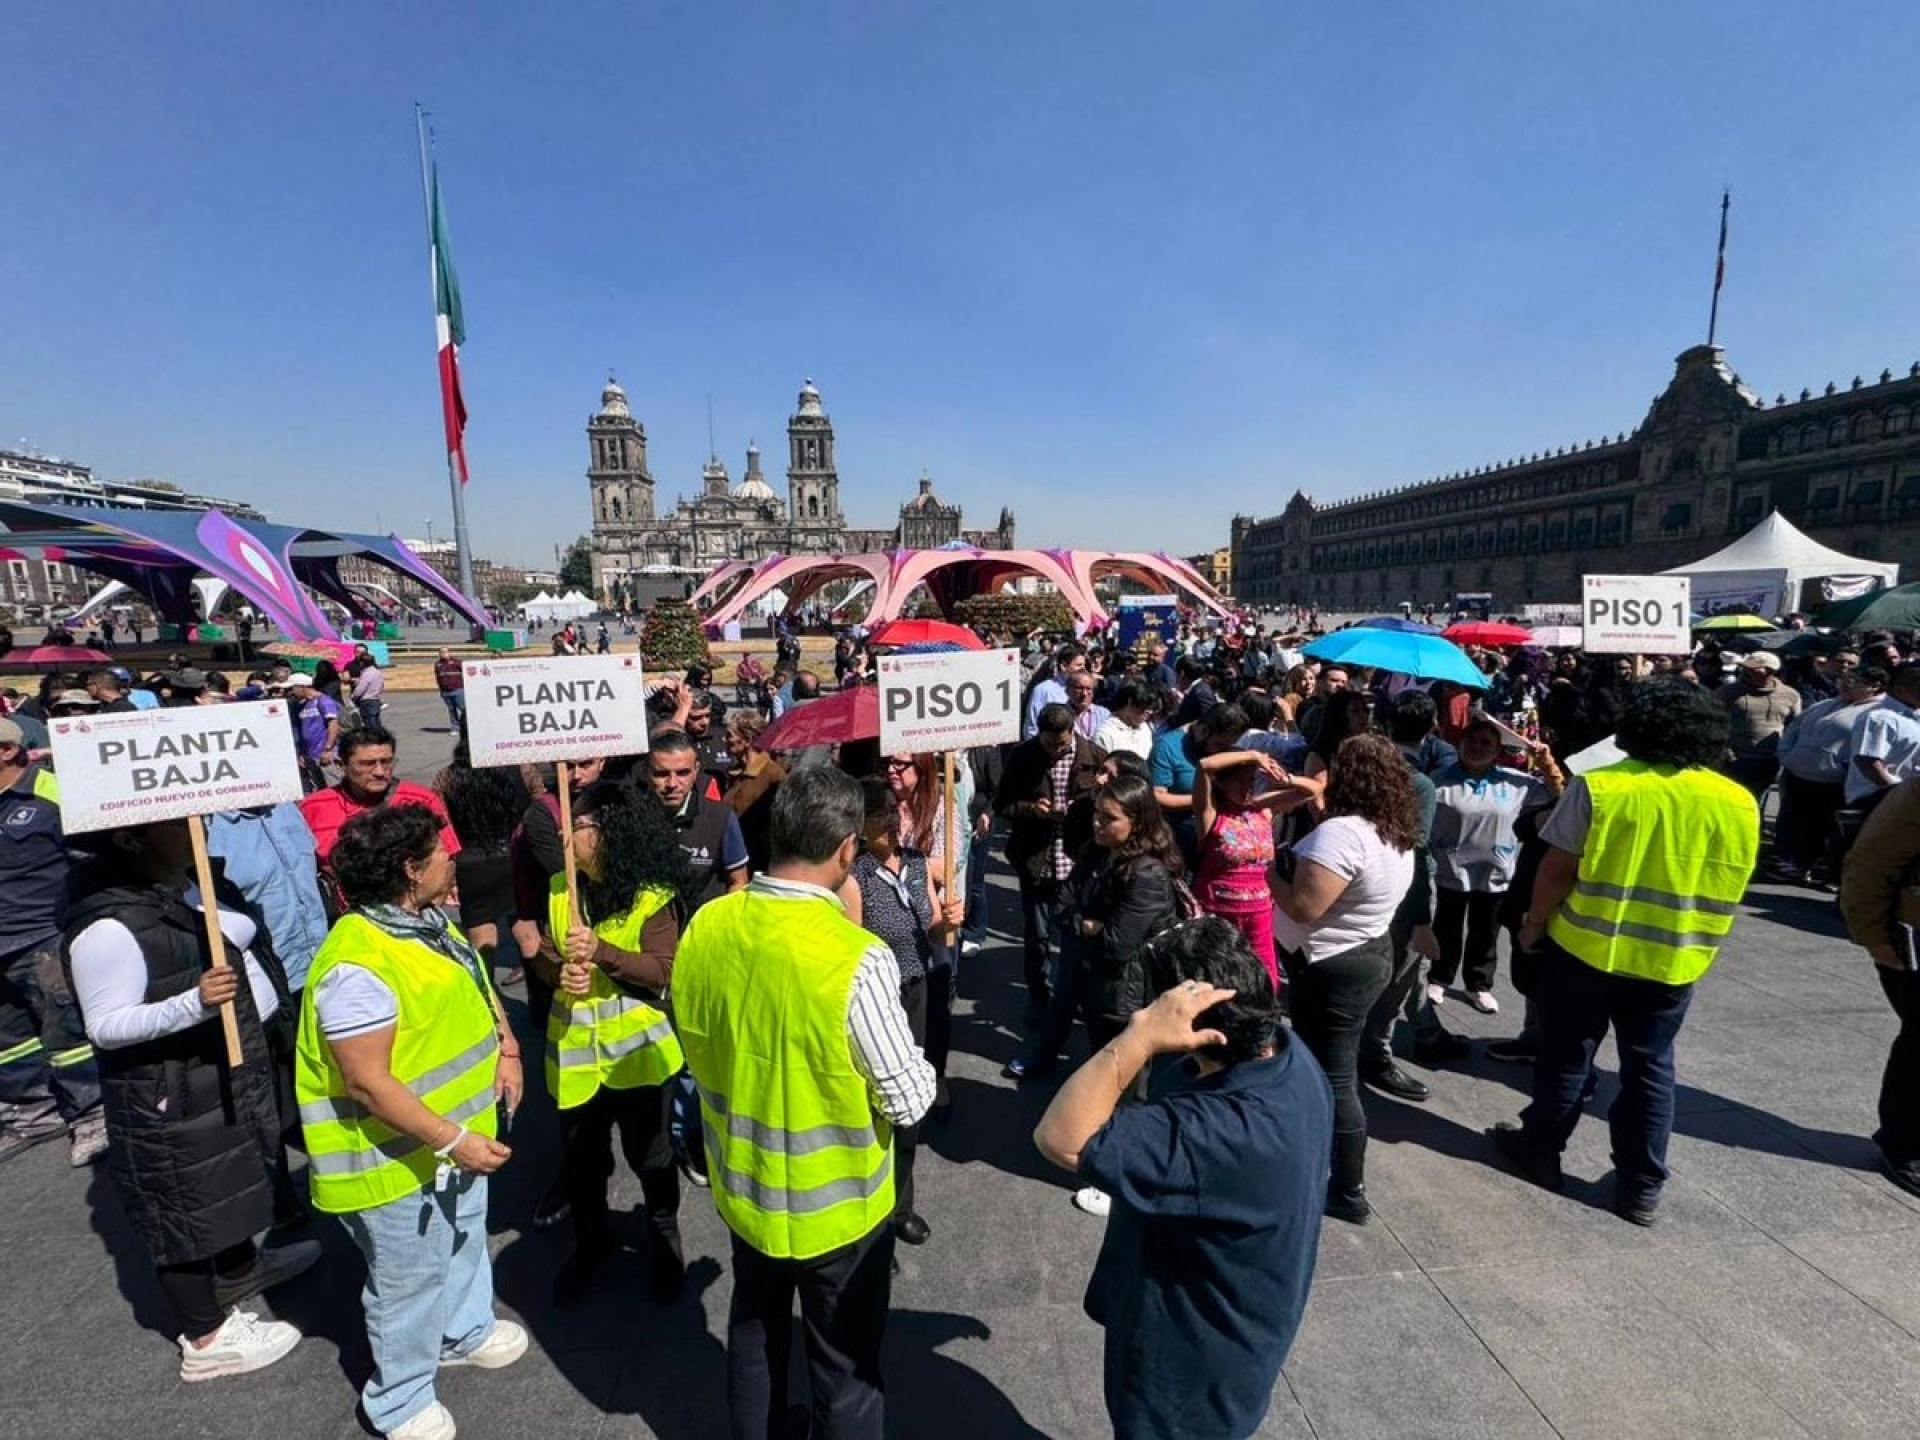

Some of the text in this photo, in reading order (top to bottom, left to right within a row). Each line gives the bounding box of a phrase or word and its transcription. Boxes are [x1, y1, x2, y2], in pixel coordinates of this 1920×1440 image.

[1589, 599, 1663, 626] PISO
[1672, 601, 1683, 628] 1
[495, 679, 616, 707] PLANTA
[885, 679, 1011, 722] PISO 1
[518, 708, 599, 734] BAJA
[99, 728, 260, 765] PLANTA
[495, 733, 623, 750] EDIFICIO NUEVO DE GOBIERNO
[131, 759, 241, 792] BAJA
[99, 781, 272, 811] EDIFICIO NUEVO DE GOBIERNO
